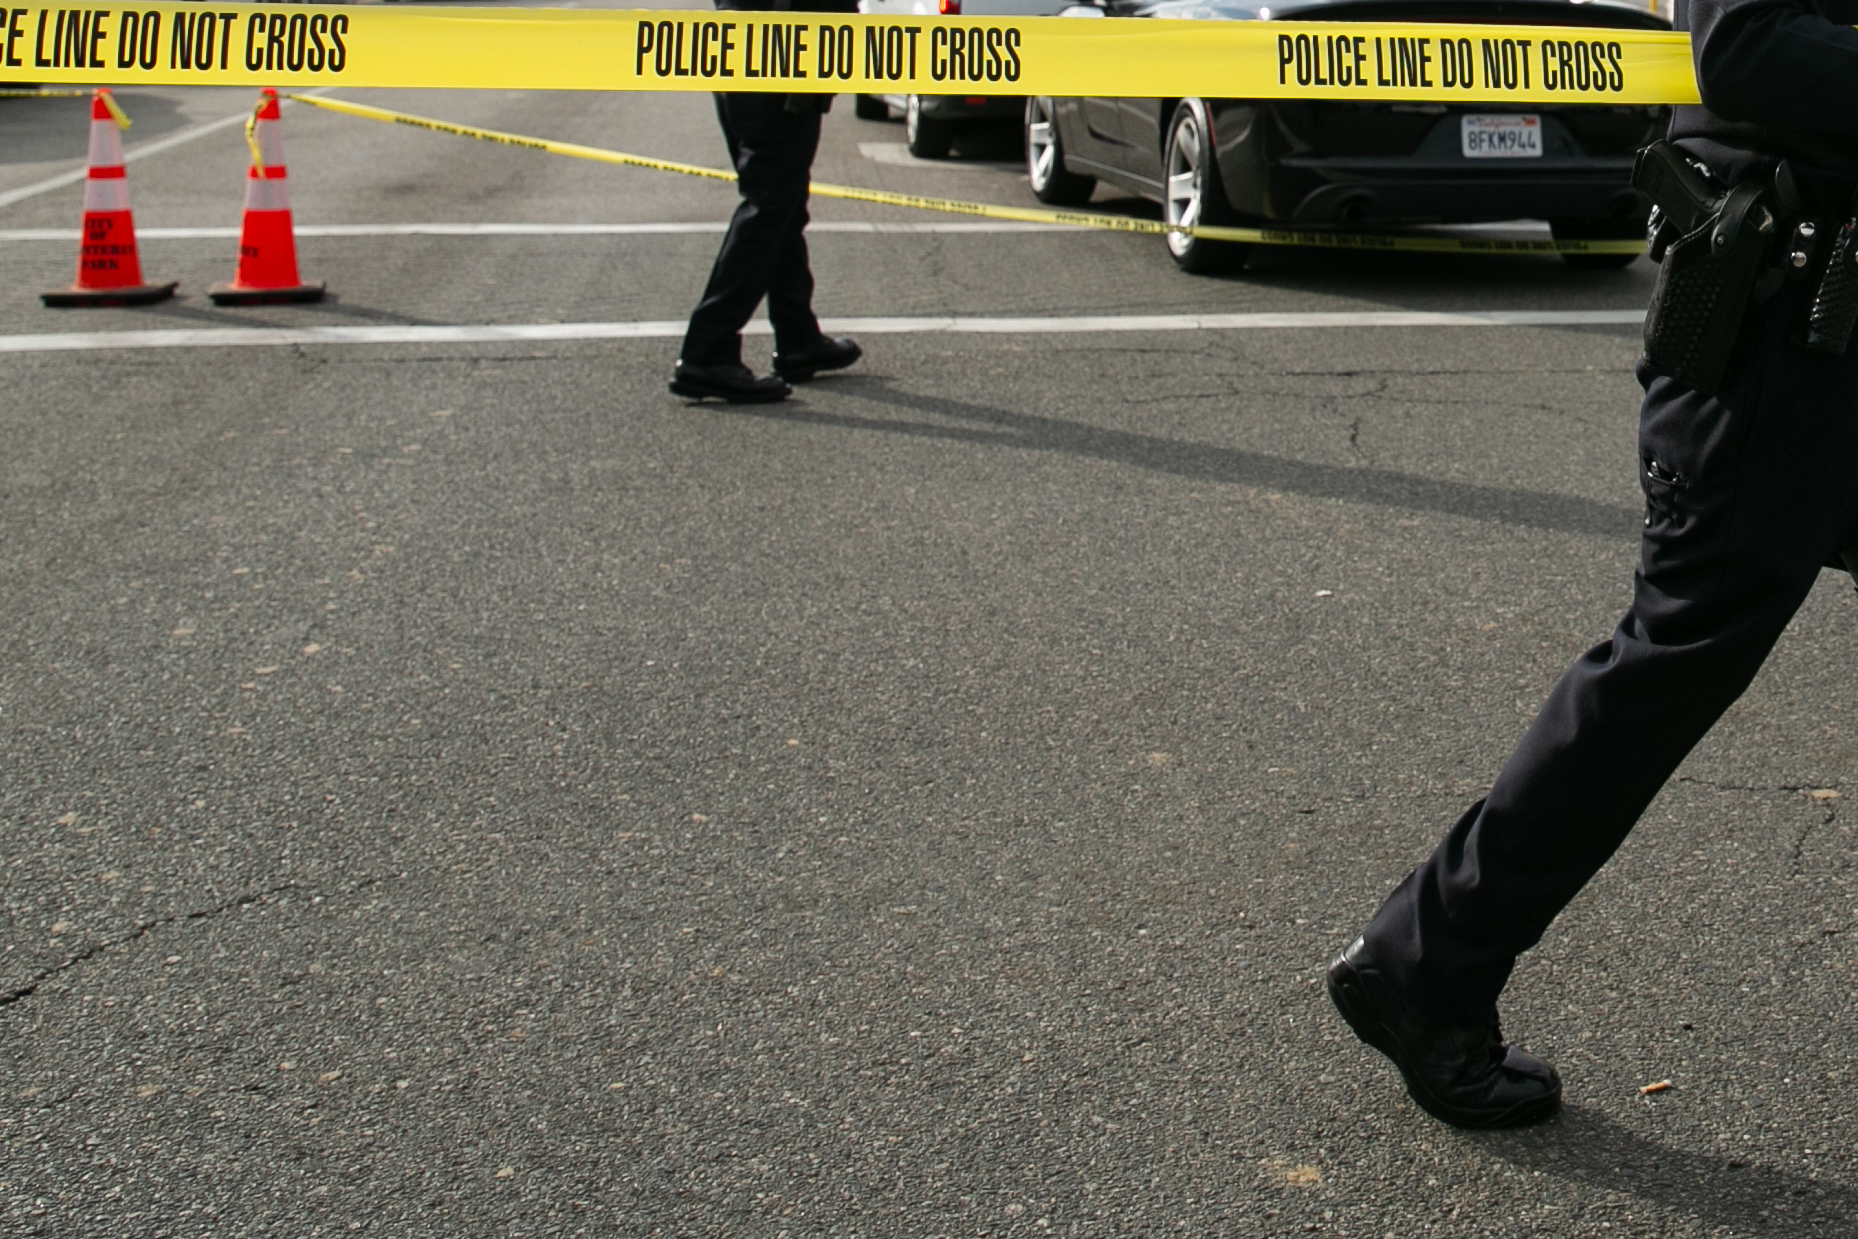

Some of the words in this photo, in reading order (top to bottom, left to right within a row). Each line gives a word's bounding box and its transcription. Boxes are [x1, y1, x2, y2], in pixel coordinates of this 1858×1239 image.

[35, 9, 110, 68] LINE
[117, 10, 161, 70] DO
[170, 11, 238, 70] NOT
[245, 12, 349, 73] CROSS
[636, 20, 737, 78] POLICE
[745, 23, 809, 79] LINE
[817, 24, 854, 80] DO
[864, 25, 922, 80] NOT
[931, 26, 1022, 82] CROSS
[1278, 33, 1368, 87] POLICE
[1375, 36, 1433, 88] LINE
[1440, 37, 1475, 89] DO
[1481, 38, 1532, 90] NOT
[1541, 39, 1625, 93] CROSS
